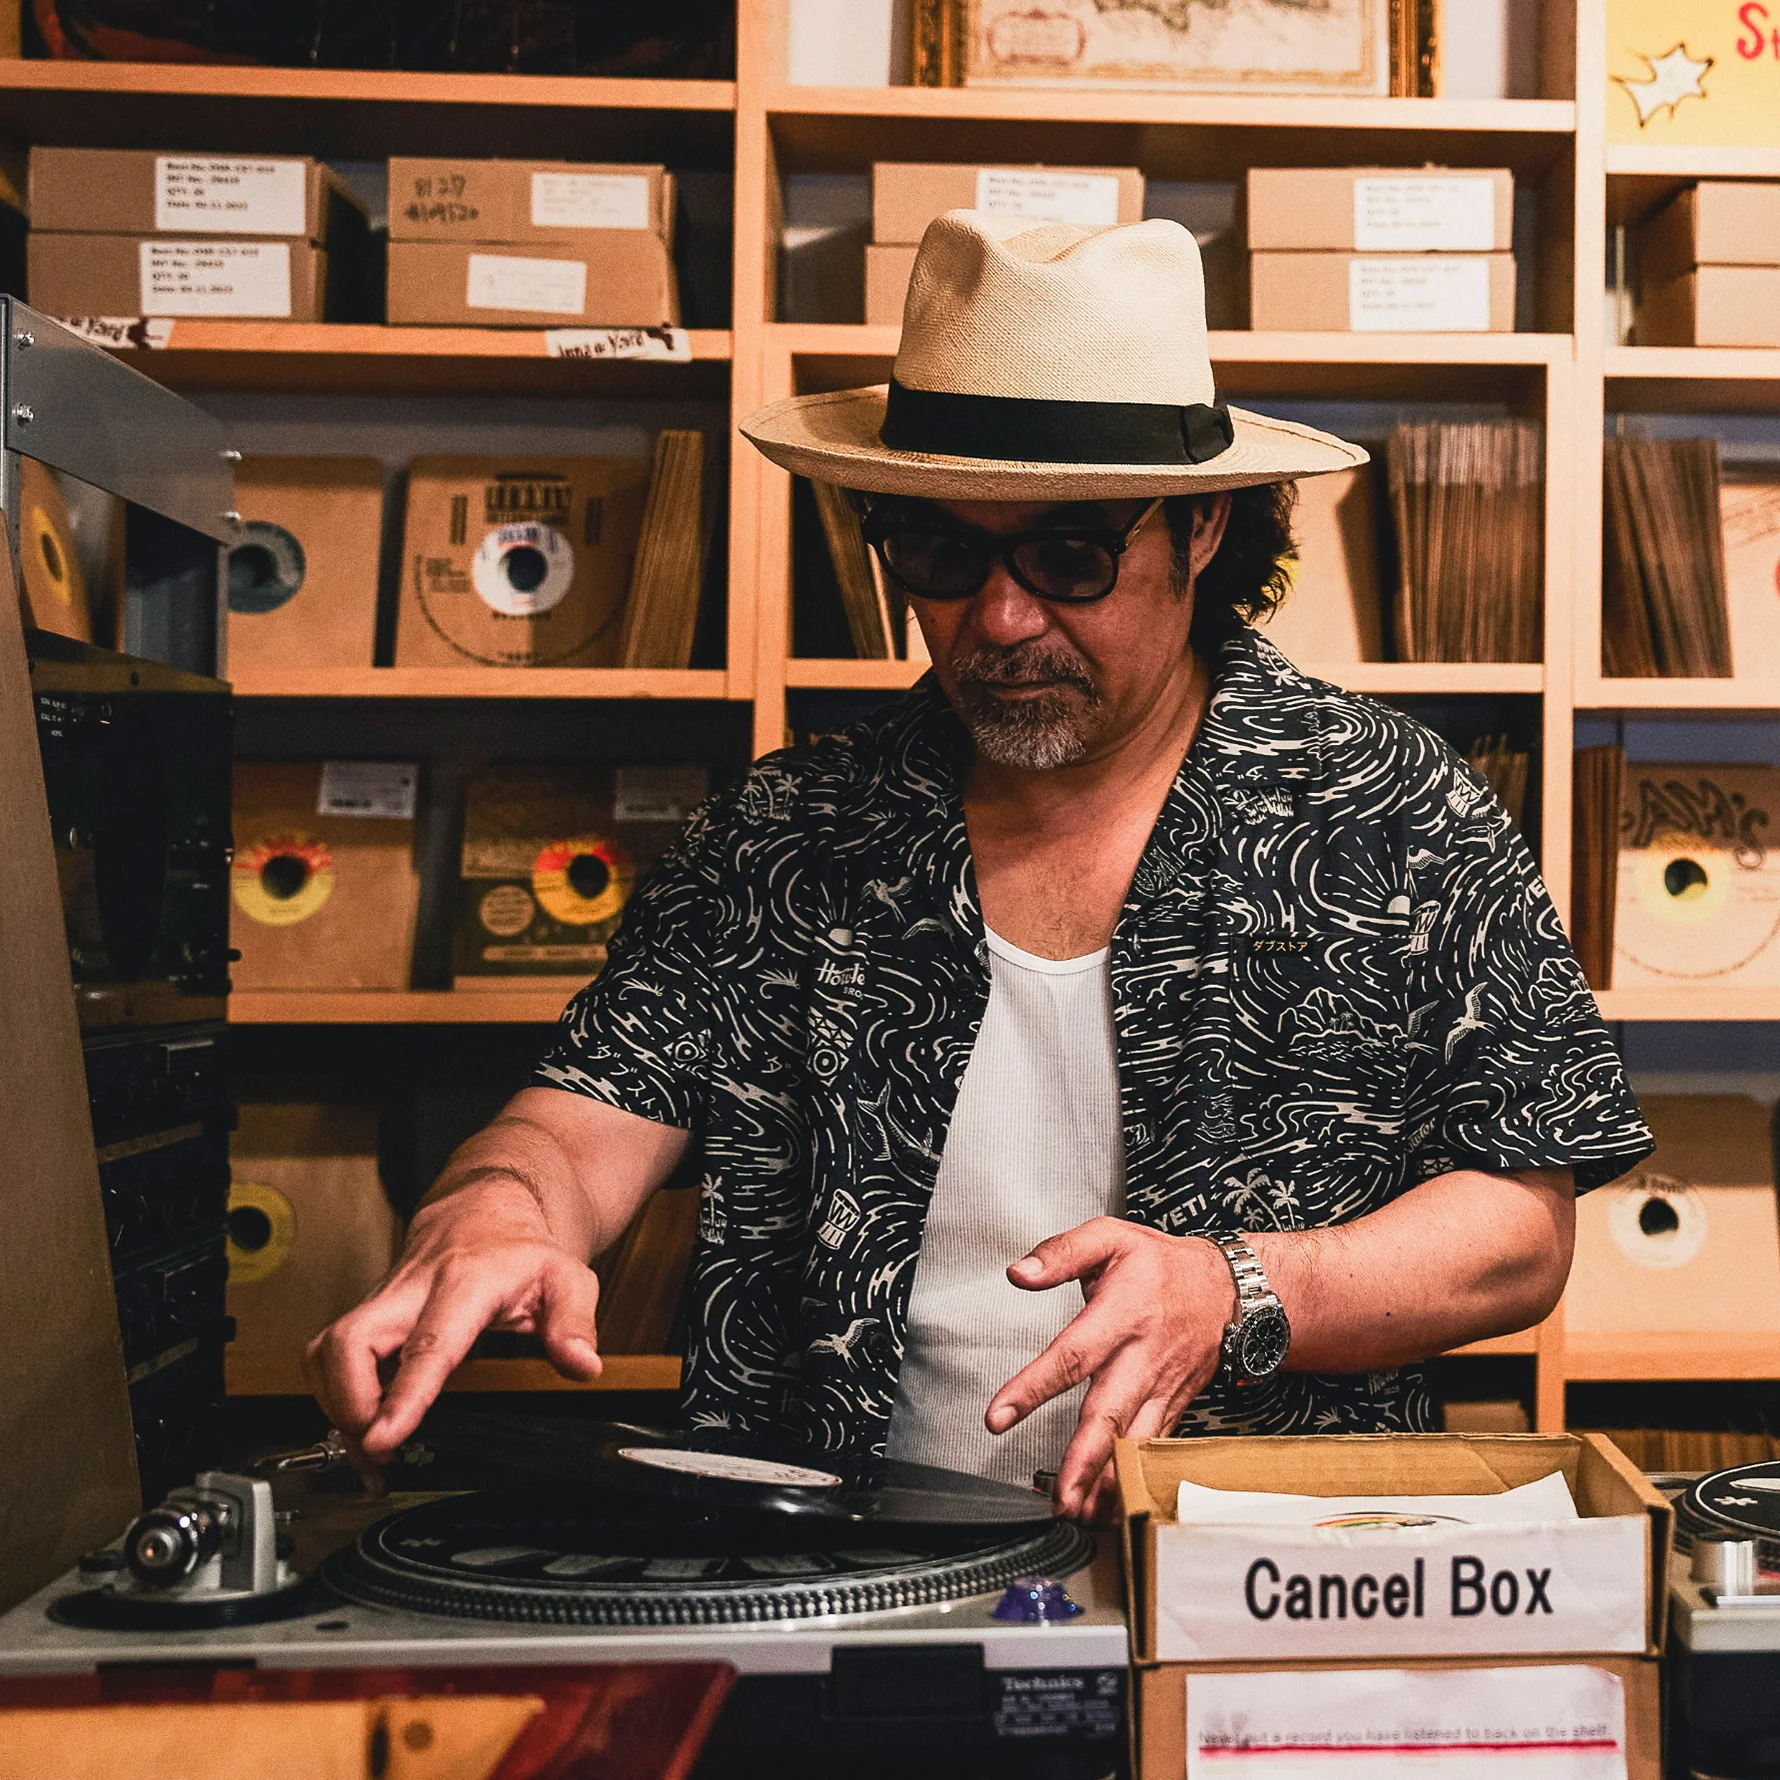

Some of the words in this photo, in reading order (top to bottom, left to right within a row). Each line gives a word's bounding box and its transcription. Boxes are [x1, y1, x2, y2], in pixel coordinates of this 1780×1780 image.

[1253, 940, 1308, 952] ダブストア
[1153, 1193, 1207, 1232] YETI
[1244, 1557, 1424, 1619] Cancel
[1452, 1555, 1553, 1616] Box
[1287, 1730, 1331, 1742] record
[1337, 1733, 1361, 1745] you
[1366, 1730, 1399, 1741] have
[1466, 1727, 1479, 1739] to
[1485, 1726, 1518, 1739] back
[1524, 1729, 1540, 1738] on
[1546, 1726, 1567, 1738] the
